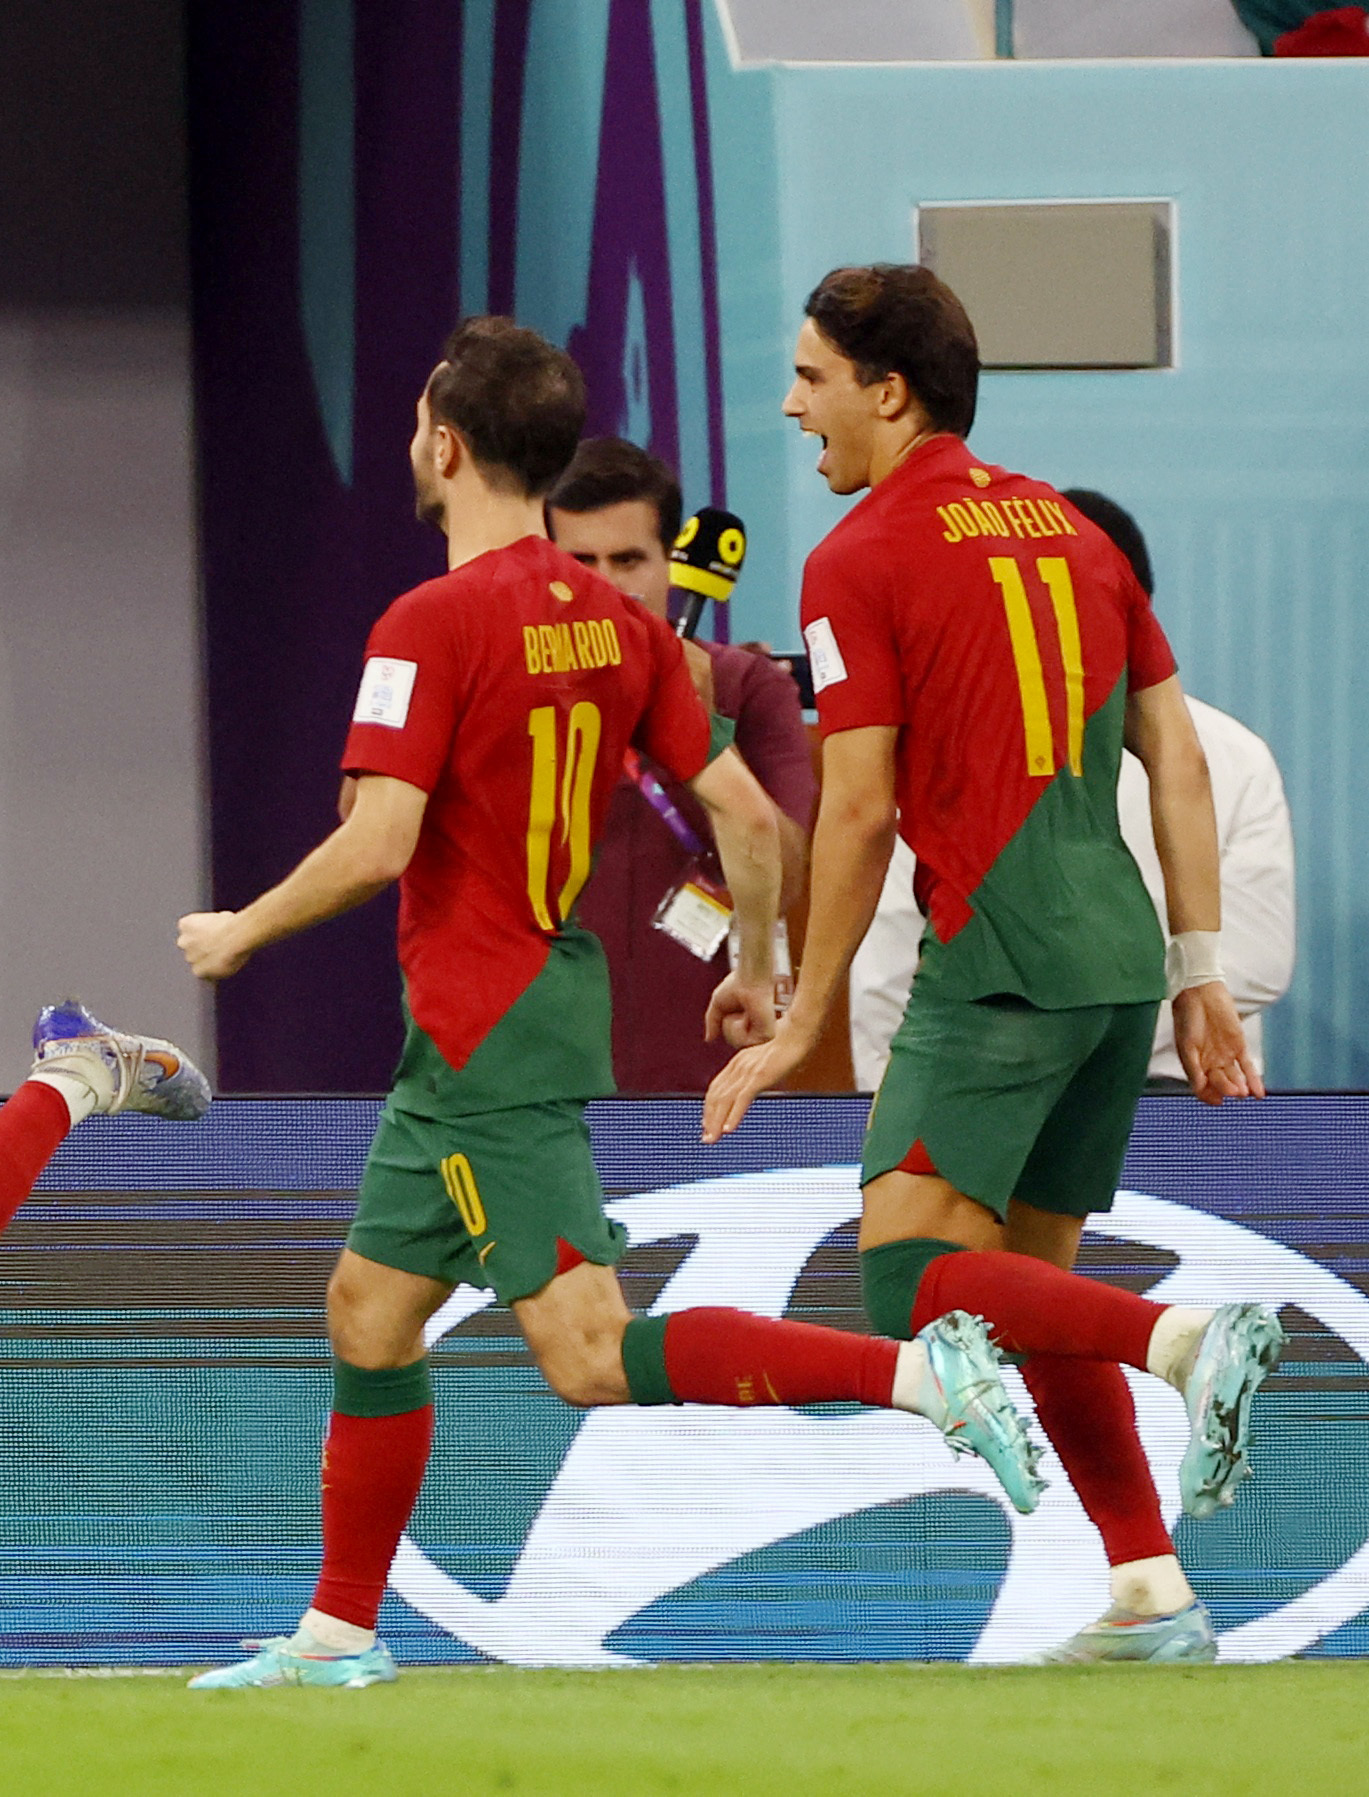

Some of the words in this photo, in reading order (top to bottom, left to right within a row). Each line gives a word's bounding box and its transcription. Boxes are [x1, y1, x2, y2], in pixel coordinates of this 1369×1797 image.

[936, 497, 1010, 543] JOÃO
[522, 618, 622, 675] BEARDO
[987, 556, 1085, 778] 11
[526, 701, 602, 931] 10
